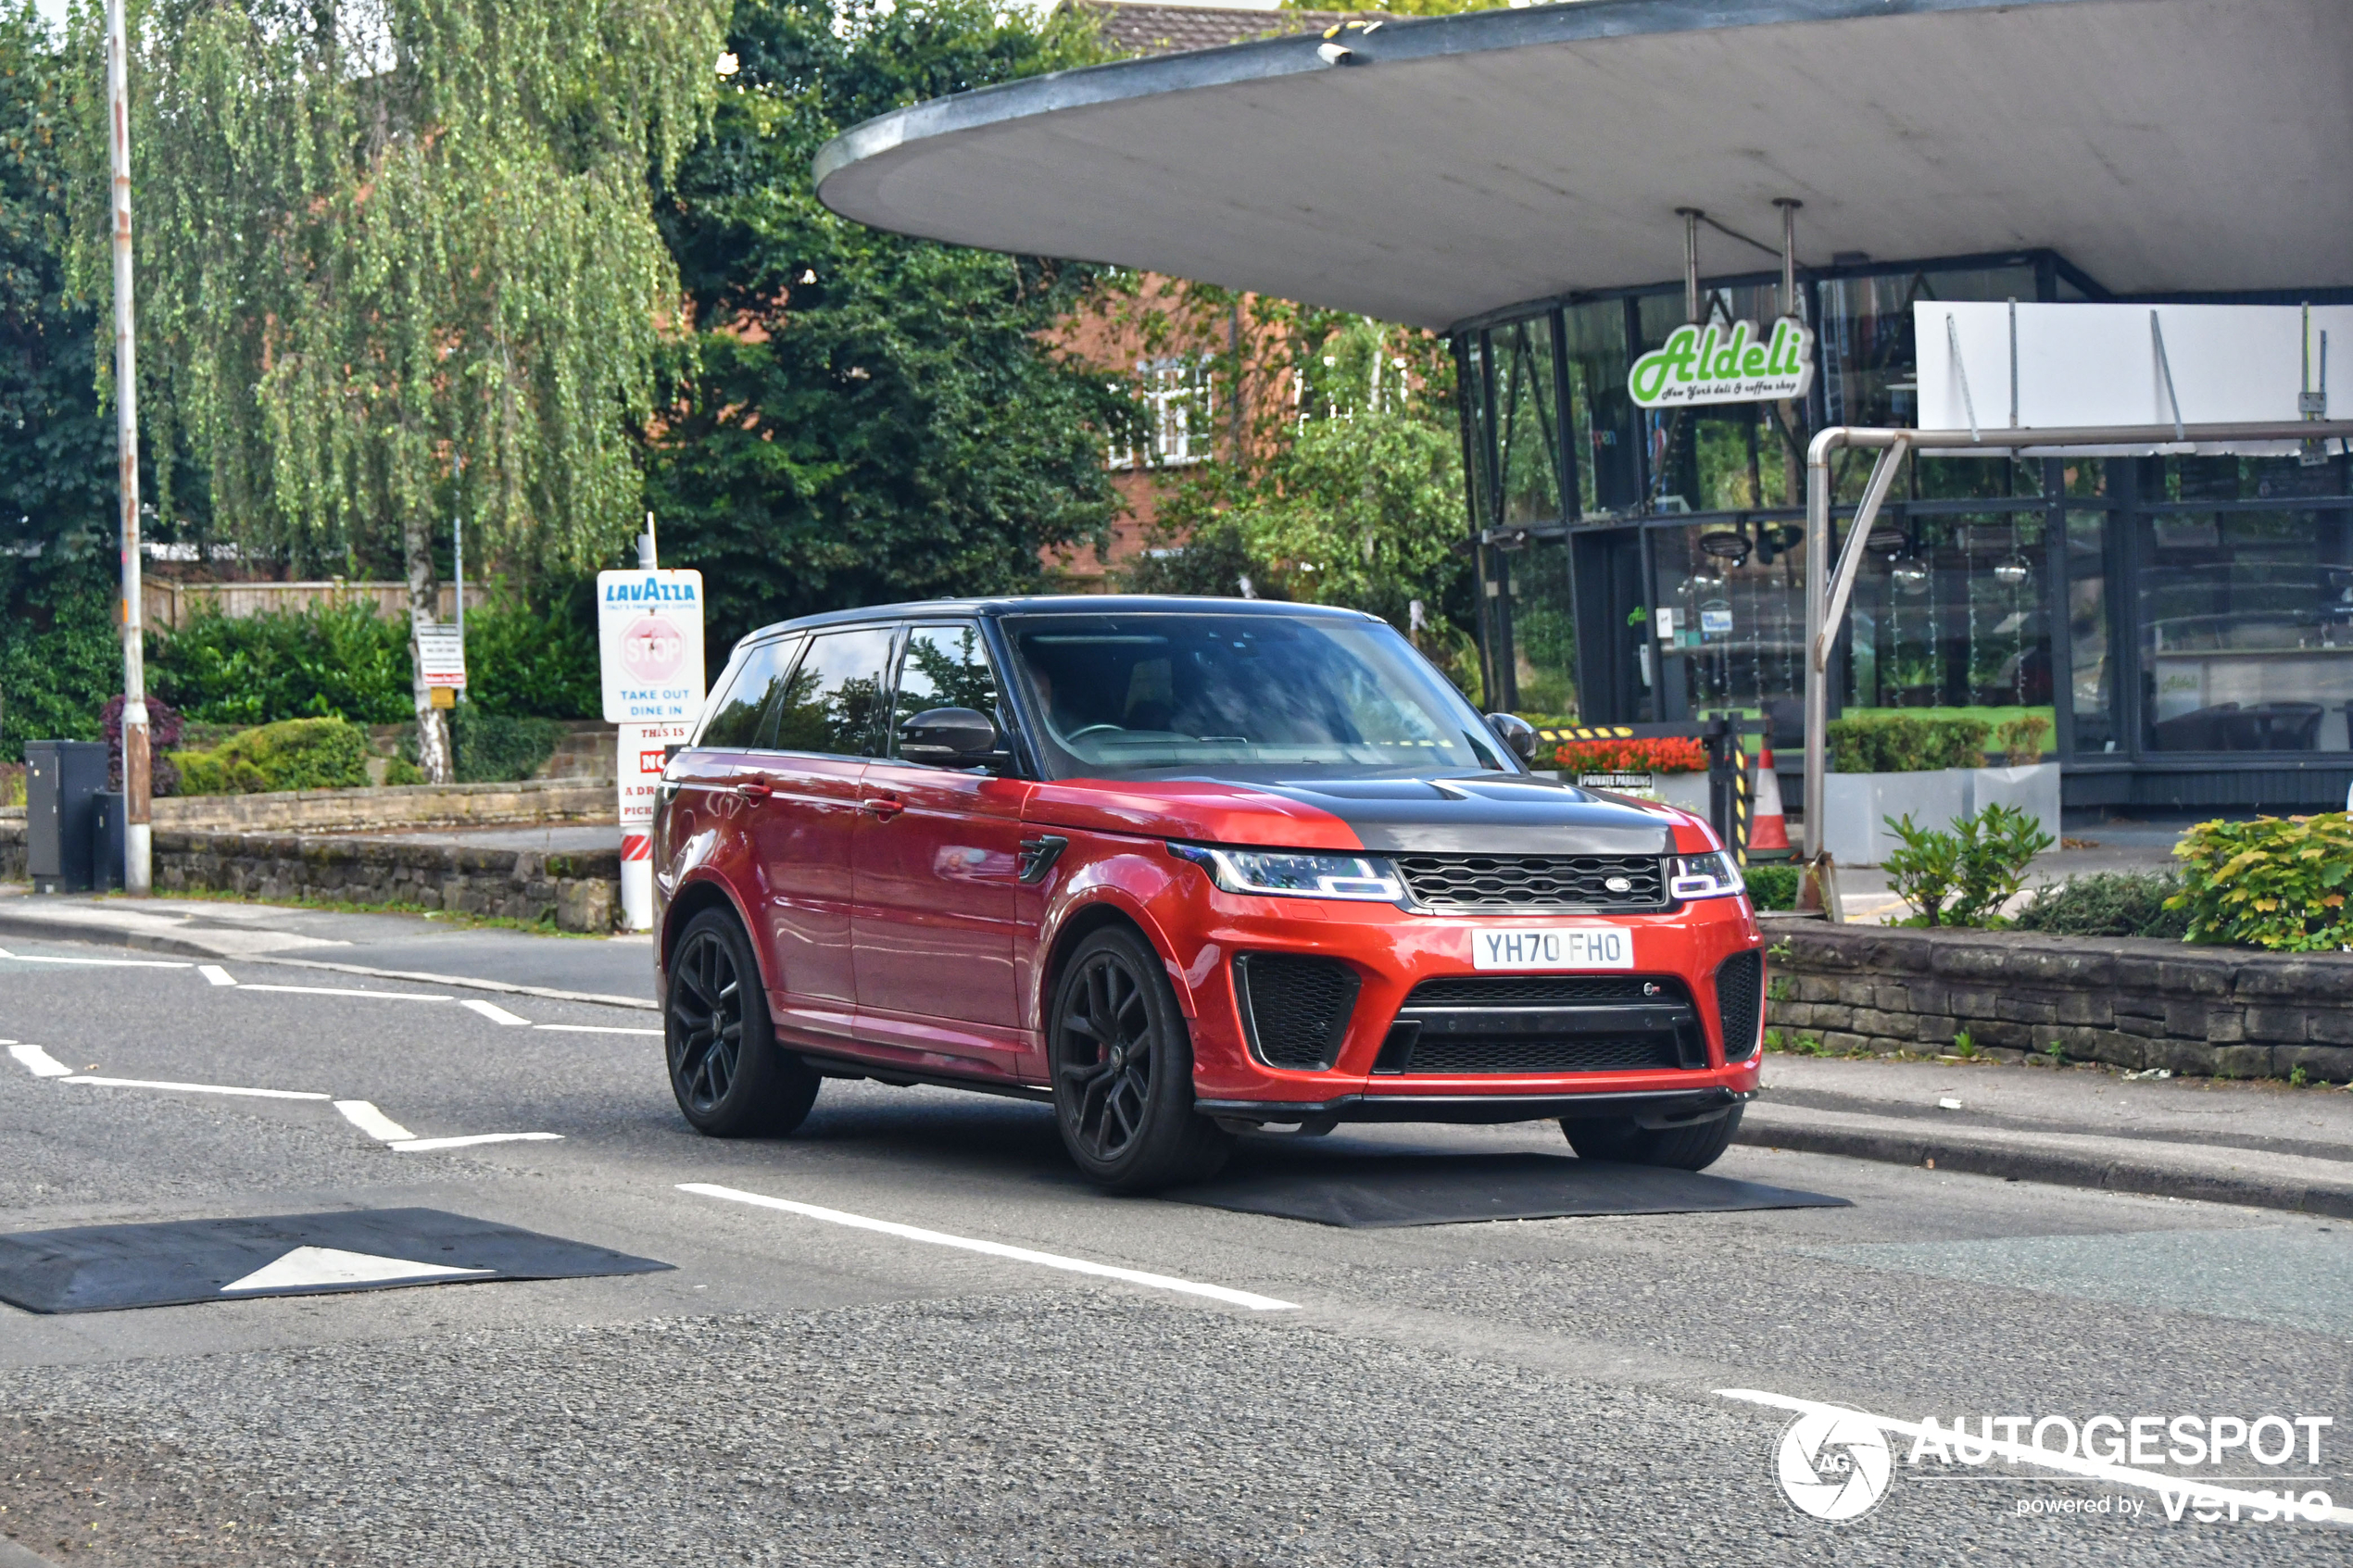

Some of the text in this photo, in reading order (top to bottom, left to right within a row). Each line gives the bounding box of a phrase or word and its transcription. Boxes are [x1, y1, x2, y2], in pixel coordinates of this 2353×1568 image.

[1632, 322, 1801, 402] Aldeli
[1662, 380, 1796, 400] New York deli & coffee shop
[606, 577, 696, 601] LAVAZZA
[626, 637, 681, 663] STOP
[621, 689, 689, 700] TAKE OUT
[631, 706, 683, 715] DINE IN
[641, 727, 685, 738] THIS IS
[642, 754, 666, 771] NO
[1583, 774, 1651, 786] PRIVATE PARKING
[625, 786, 656, 796] A DR
[1486, 934, 1621, 962] YH70 FHO
